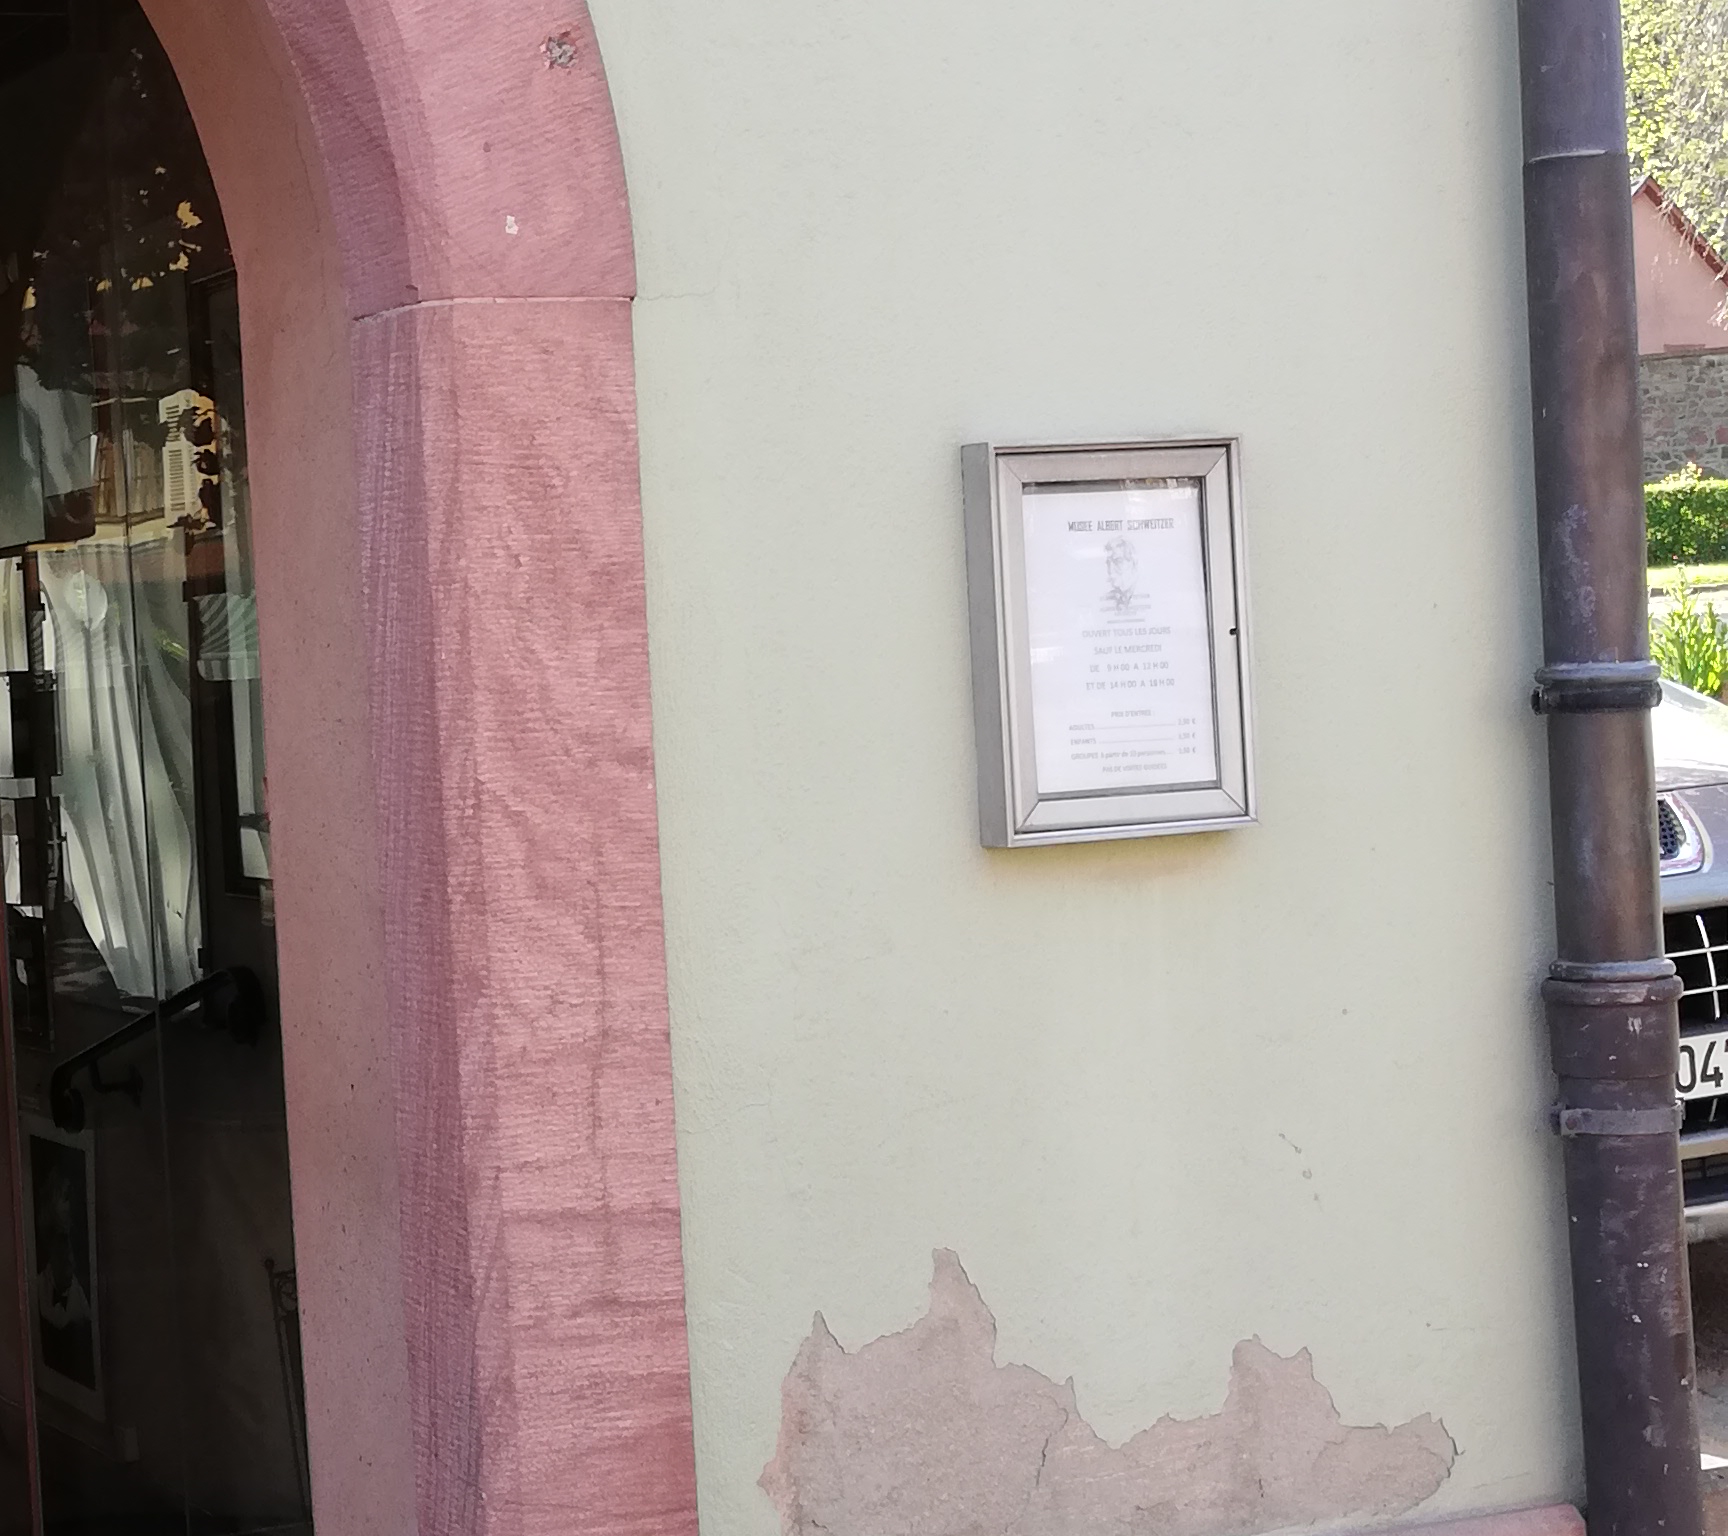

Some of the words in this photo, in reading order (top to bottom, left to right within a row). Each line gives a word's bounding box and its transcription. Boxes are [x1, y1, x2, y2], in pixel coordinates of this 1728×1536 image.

[1067, 521, 1092, 532] MUSEE
[1097, 520, 1123, 531] ALBERT
[1126, 518, 1174, 530] SCHWEITZER
[1675, 1039, 1728, 1093] 04
